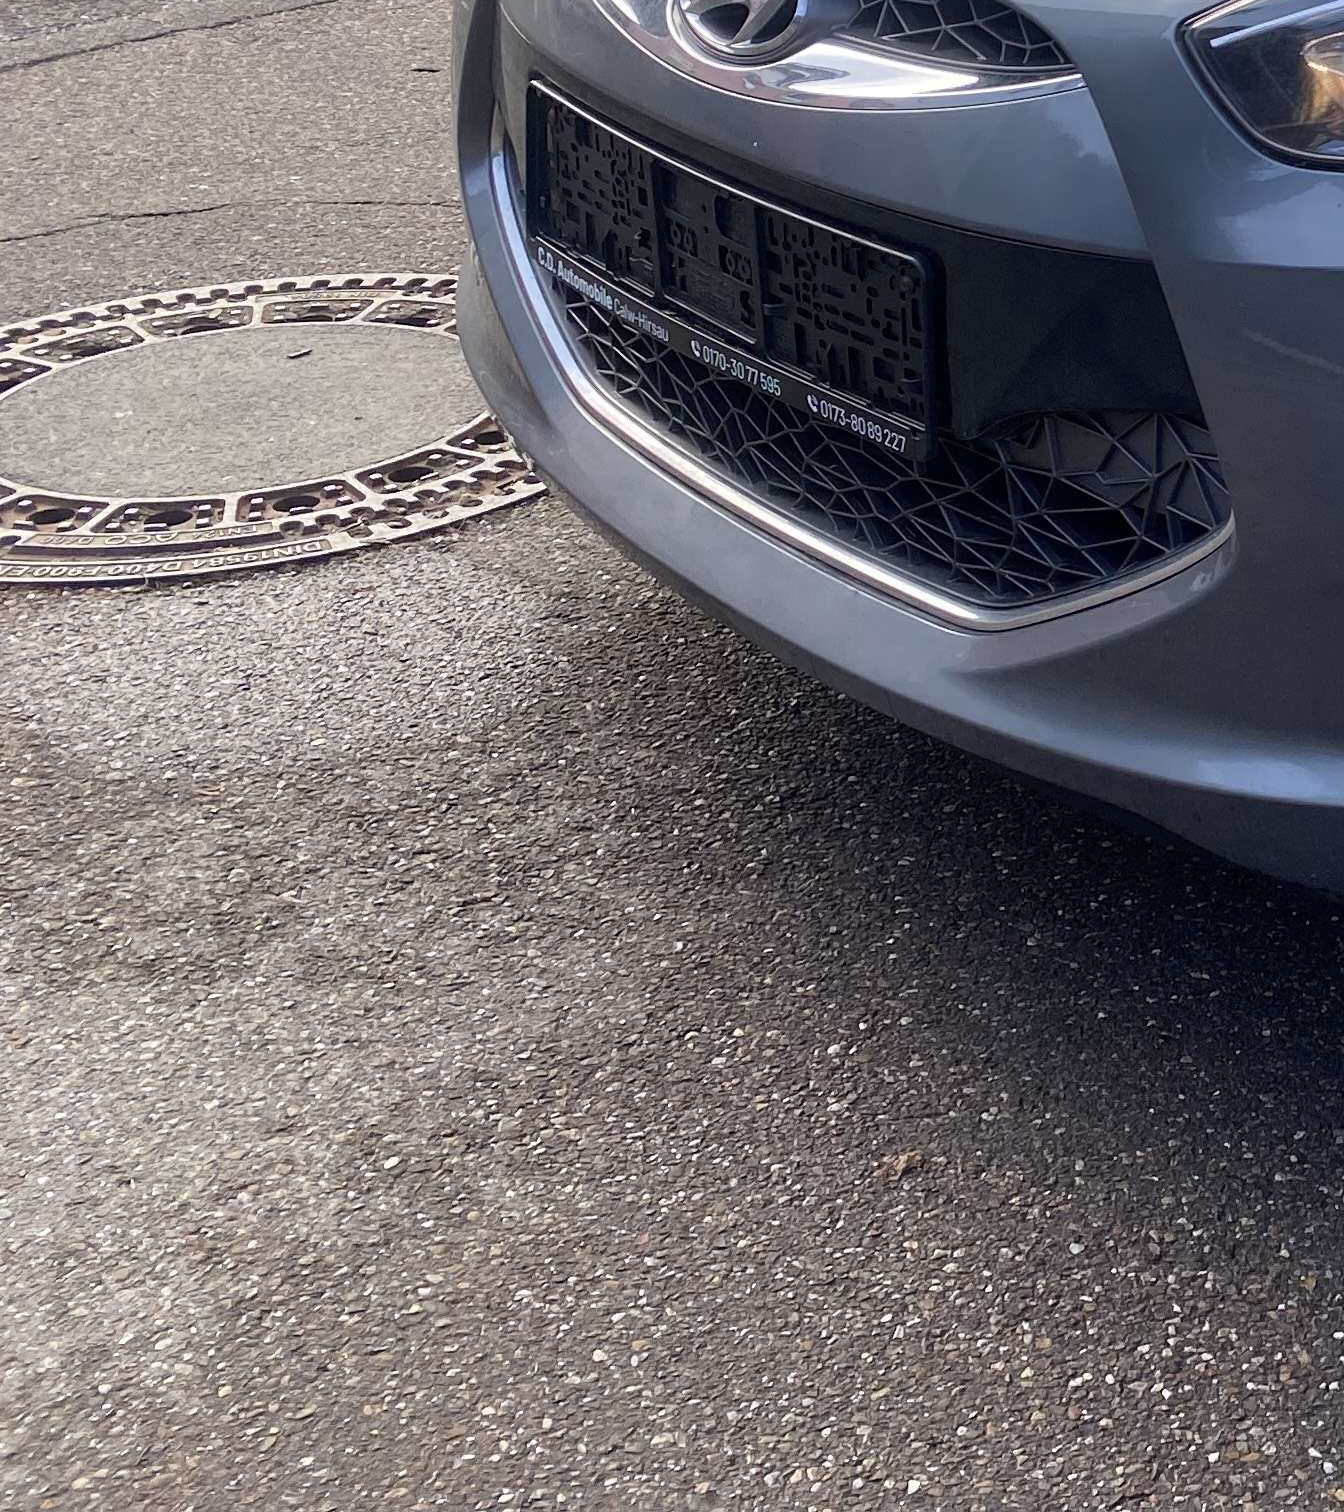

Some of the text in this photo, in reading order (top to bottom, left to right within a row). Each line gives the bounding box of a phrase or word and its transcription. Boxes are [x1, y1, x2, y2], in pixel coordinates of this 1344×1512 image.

[537, 246, 556, 273] C.D.
[557, 259, 613, 310] Automobile
[613, 298, 669, 343] Calw-Hirsau
[702, 345, 744, 379] 0170-30
[760, 372, 781, 397] 595
[883, 428, 906, 453] 227
[105, 530, 179, 545] ACO
